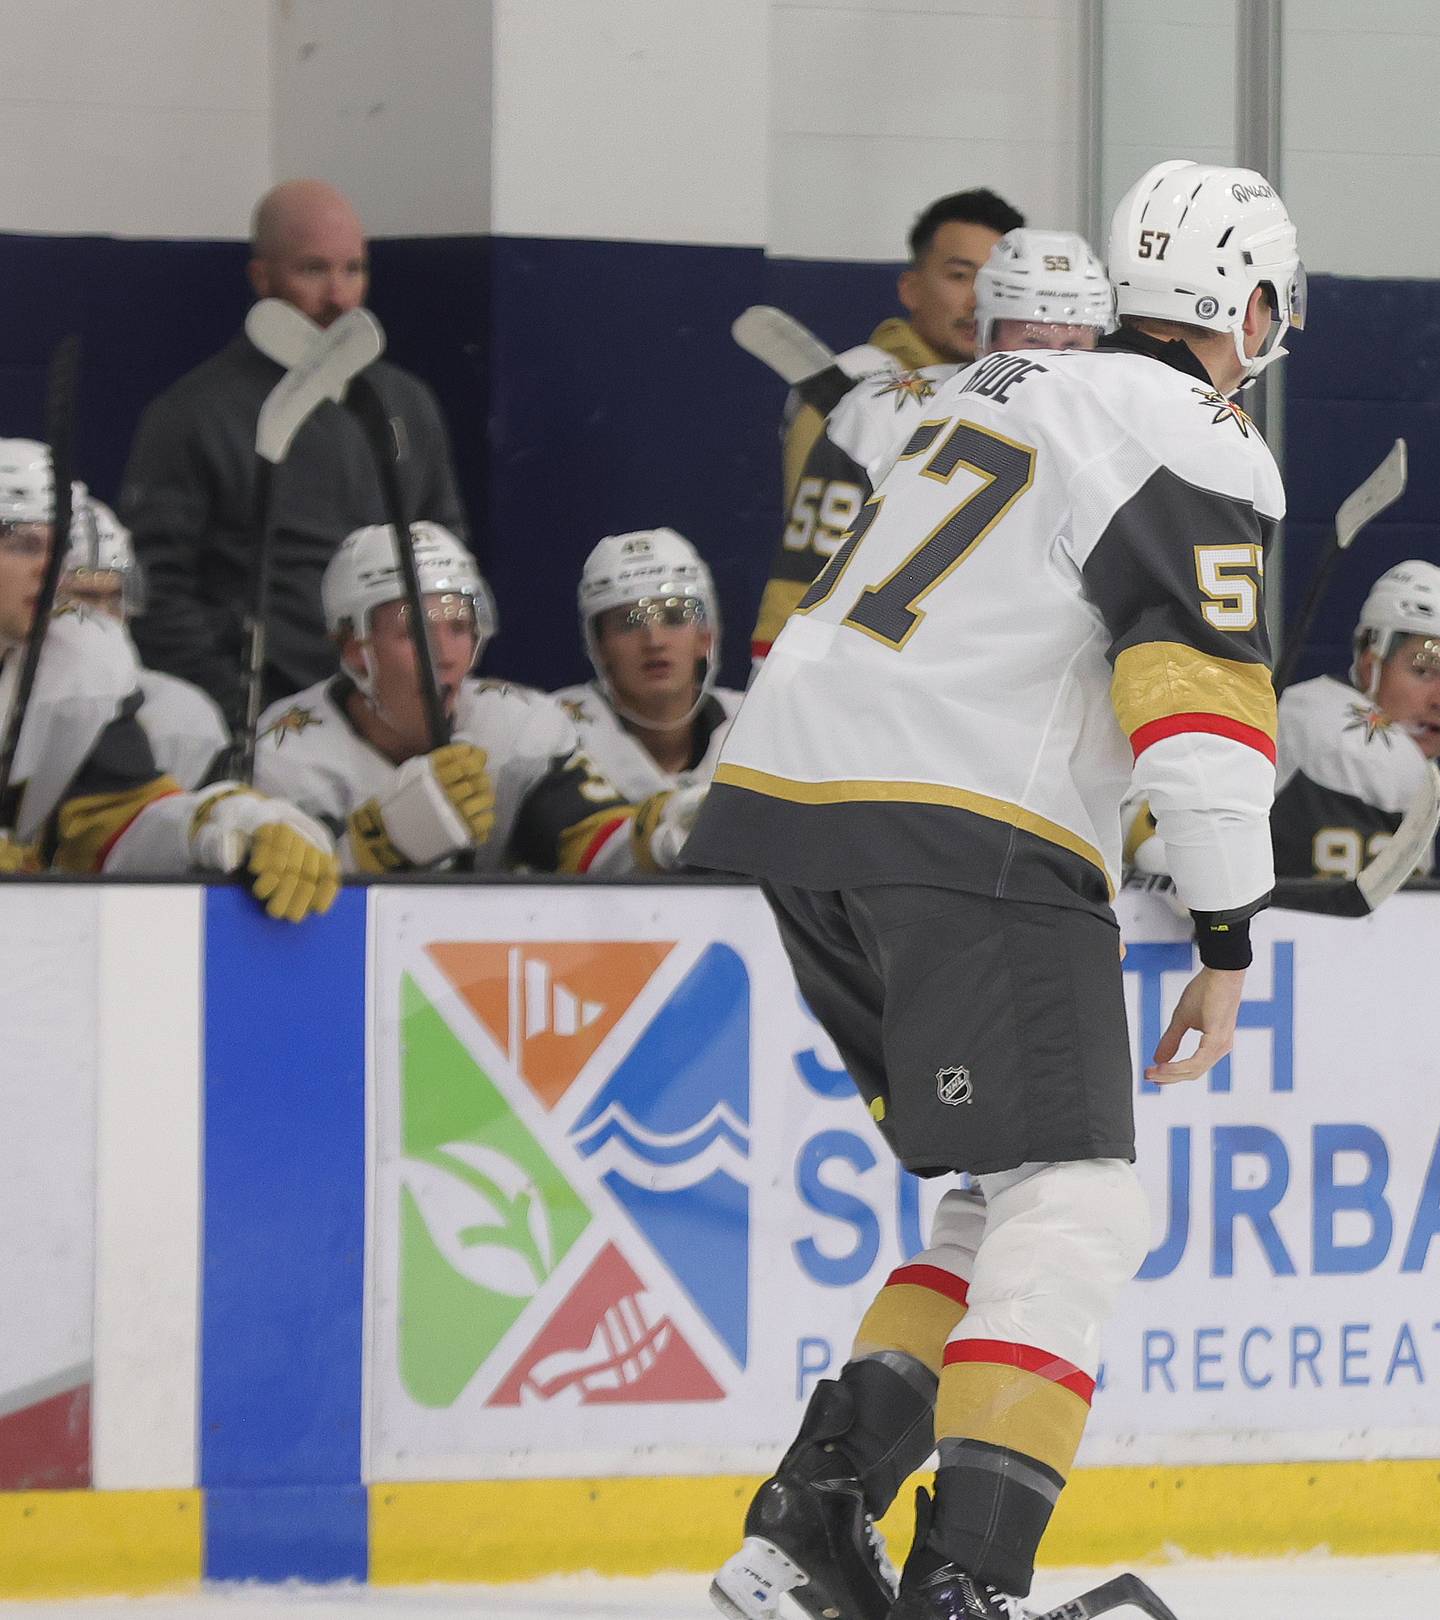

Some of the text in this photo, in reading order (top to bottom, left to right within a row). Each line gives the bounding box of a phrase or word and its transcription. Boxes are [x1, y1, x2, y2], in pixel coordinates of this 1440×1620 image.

[1138, 230, 1170, 260] 57
[783, 477, 864, 557] 59
[1193, 544, 1264, 632] 5
